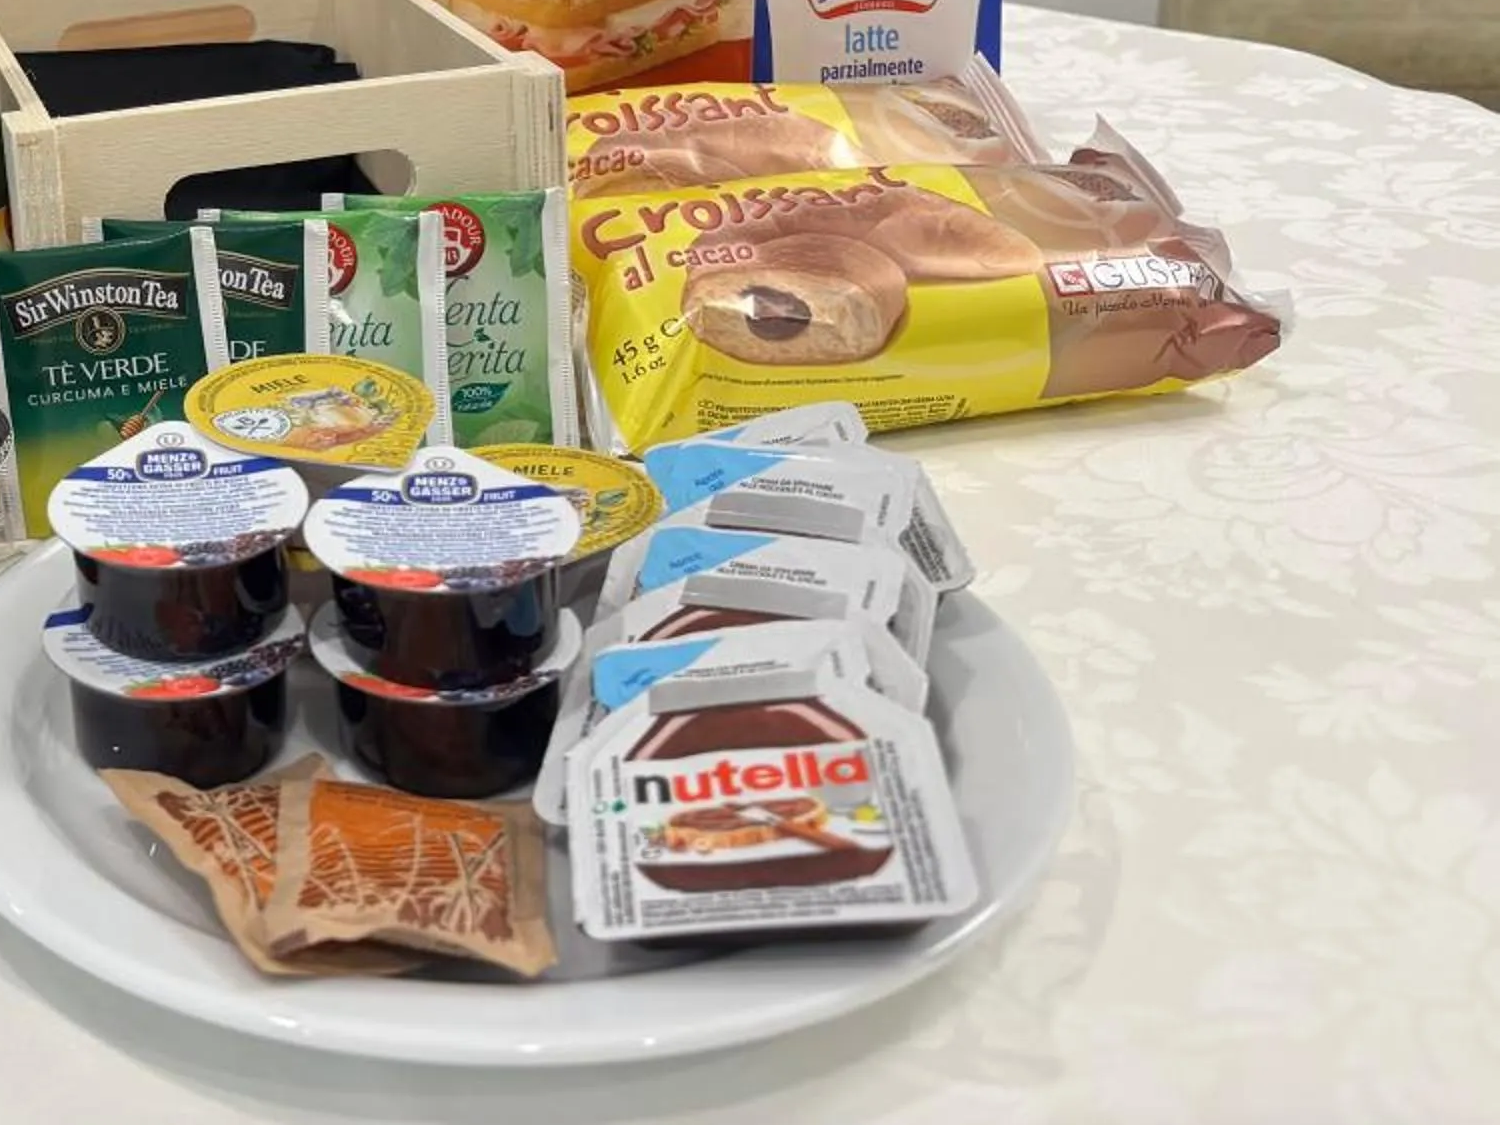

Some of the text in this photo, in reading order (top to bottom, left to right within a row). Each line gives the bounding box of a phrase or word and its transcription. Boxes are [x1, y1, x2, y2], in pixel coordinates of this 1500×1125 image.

[844, 25, 899, 54] latte
[820, 58, 924, 84] parzialmente
[581, 166, 907, 261] Croissant
[624, 244, 754, 293] al cacao
[446, 292, 522, 326] enta
[330, 312, 394, 348] nta
[448, 341, 527, 375] erita
[613, 334, 660, 366] 45 g
[42, 352, 170, 388] TÈ VERDE
[621, 355, 667, 385] 1.6 oz
[28, 376, 188, 407] CURCUMA E MIELE
[513, 463, 574, 477] MIELE
[634, 751, 869, 804] nutella
